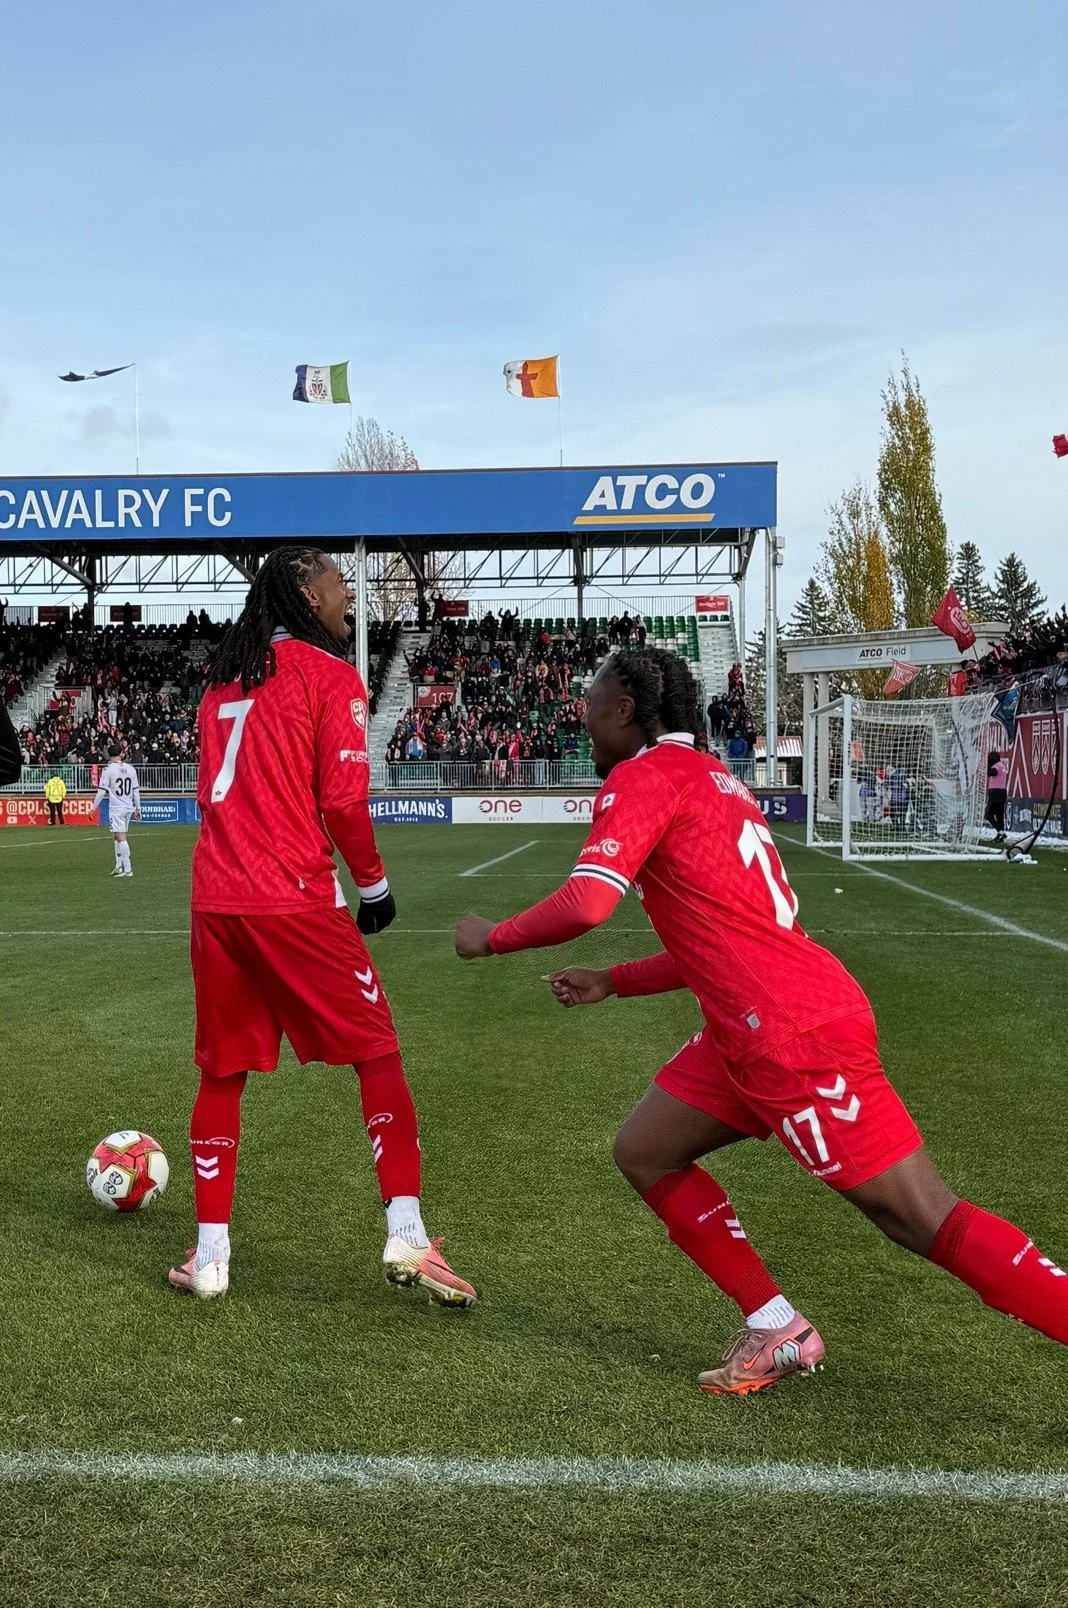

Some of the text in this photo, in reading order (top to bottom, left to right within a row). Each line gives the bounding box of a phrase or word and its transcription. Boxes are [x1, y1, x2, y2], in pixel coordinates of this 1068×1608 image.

[581, 473, 716, 511] ATCO
[0, 487, 232, 530] CAVALRY FC
[859, 646, 907, 658] ATCO Field
[210, 698, 255, 804] 7
[115, 777, 132, 797] 30
[6, 800, 94, 815] @CPLSCCER
[478, 799, 523, 813] one
[562, 799, 592, 813] on
[737, 818, 799, 930] 17
[782, 1105, 830, 1166] 17
